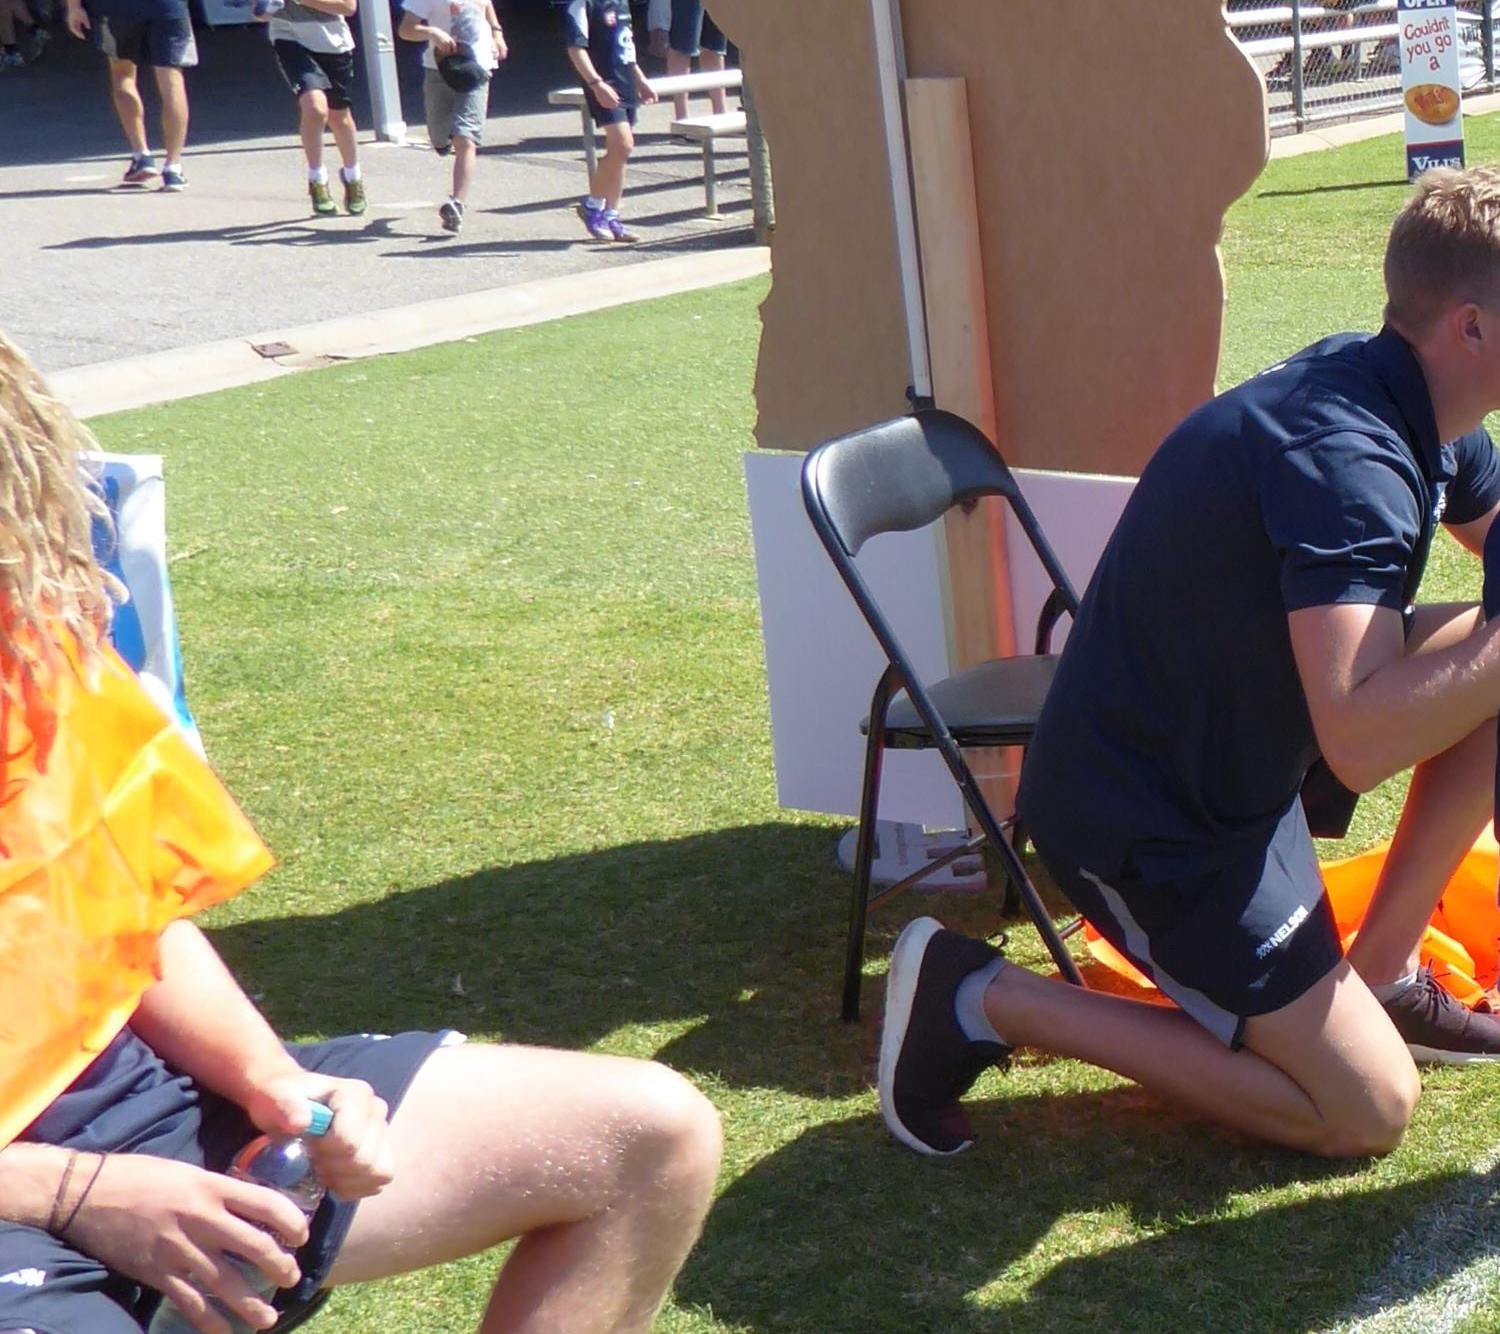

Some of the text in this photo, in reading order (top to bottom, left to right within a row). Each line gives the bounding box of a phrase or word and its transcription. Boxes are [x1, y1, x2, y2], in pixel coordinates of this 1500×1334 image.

[1406, 41, 1432, 64] you
[1434, 34, 1452, 53] go
[1429, 55, 1441, 71] a
